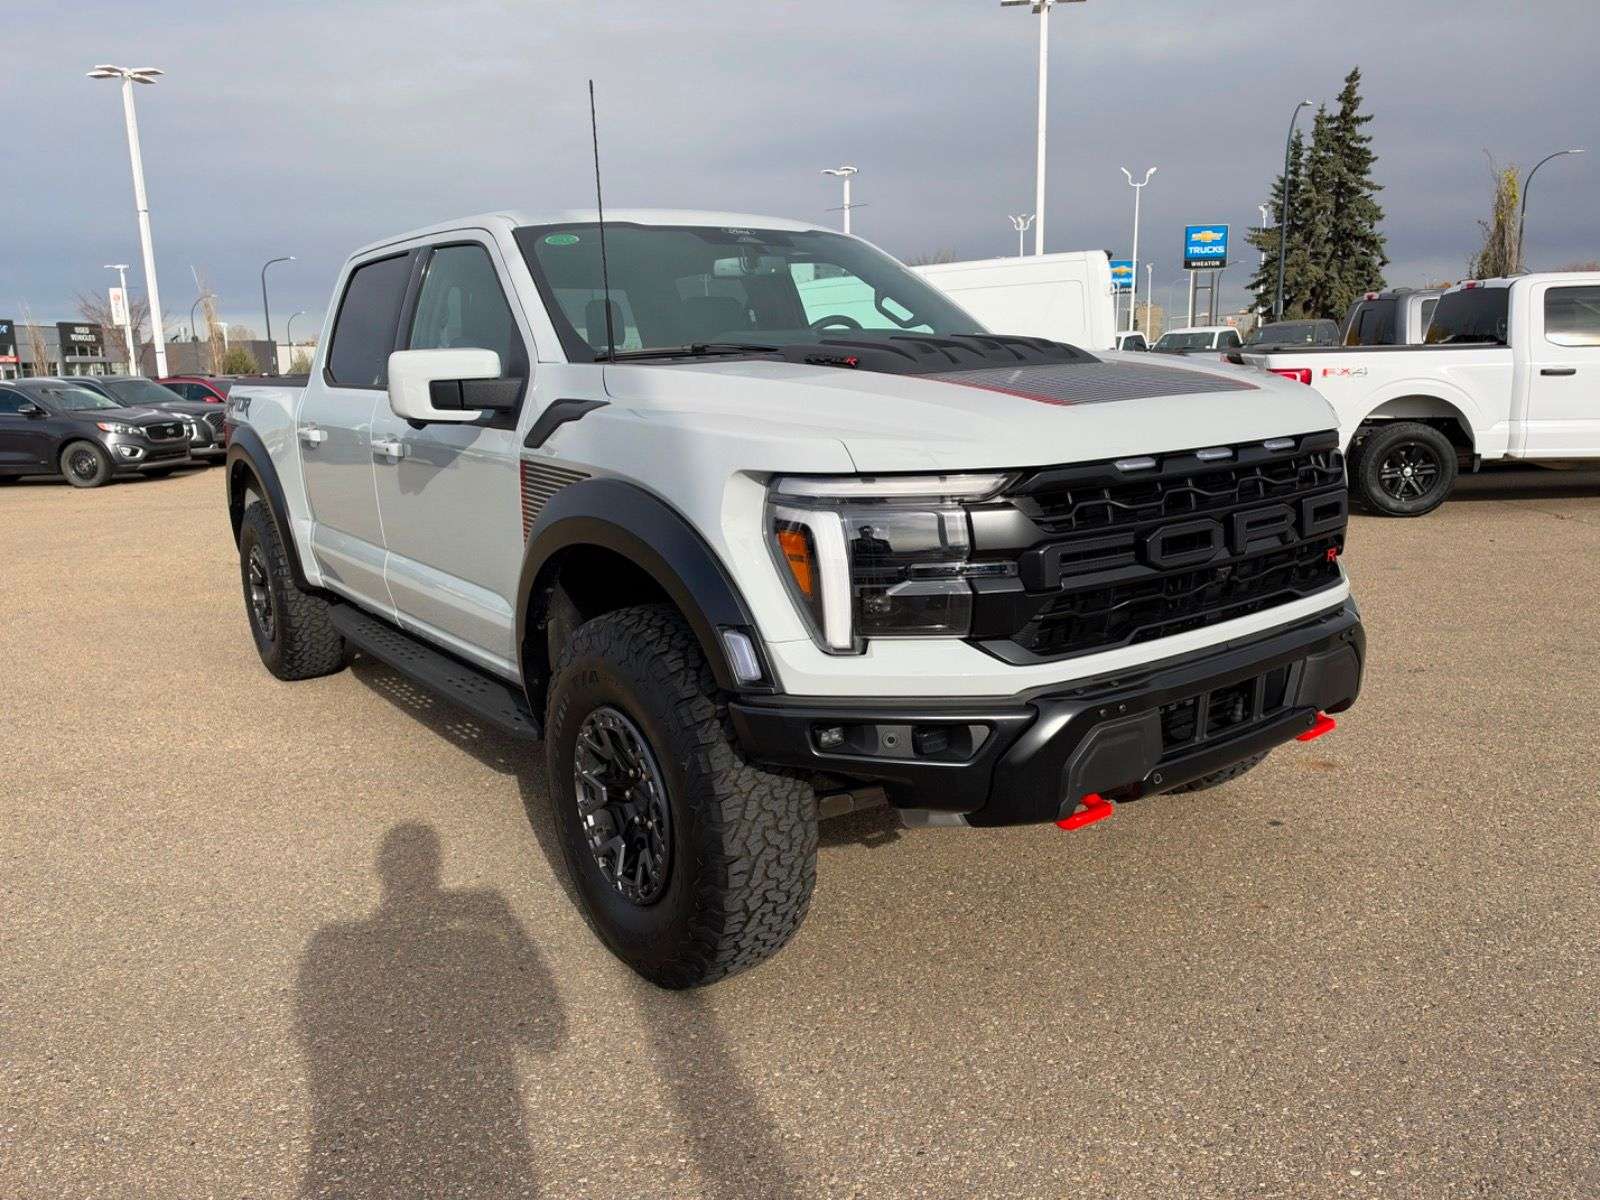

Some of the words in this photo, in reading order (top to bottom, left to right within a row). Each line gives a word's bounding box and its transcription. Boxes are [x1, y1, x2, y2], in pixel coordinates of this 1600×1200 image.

[1188, 245, 1225, 254] TRUCKS
[1022, 489, 1349, 592] FORD
[1327, 546, 1337, 561] R
